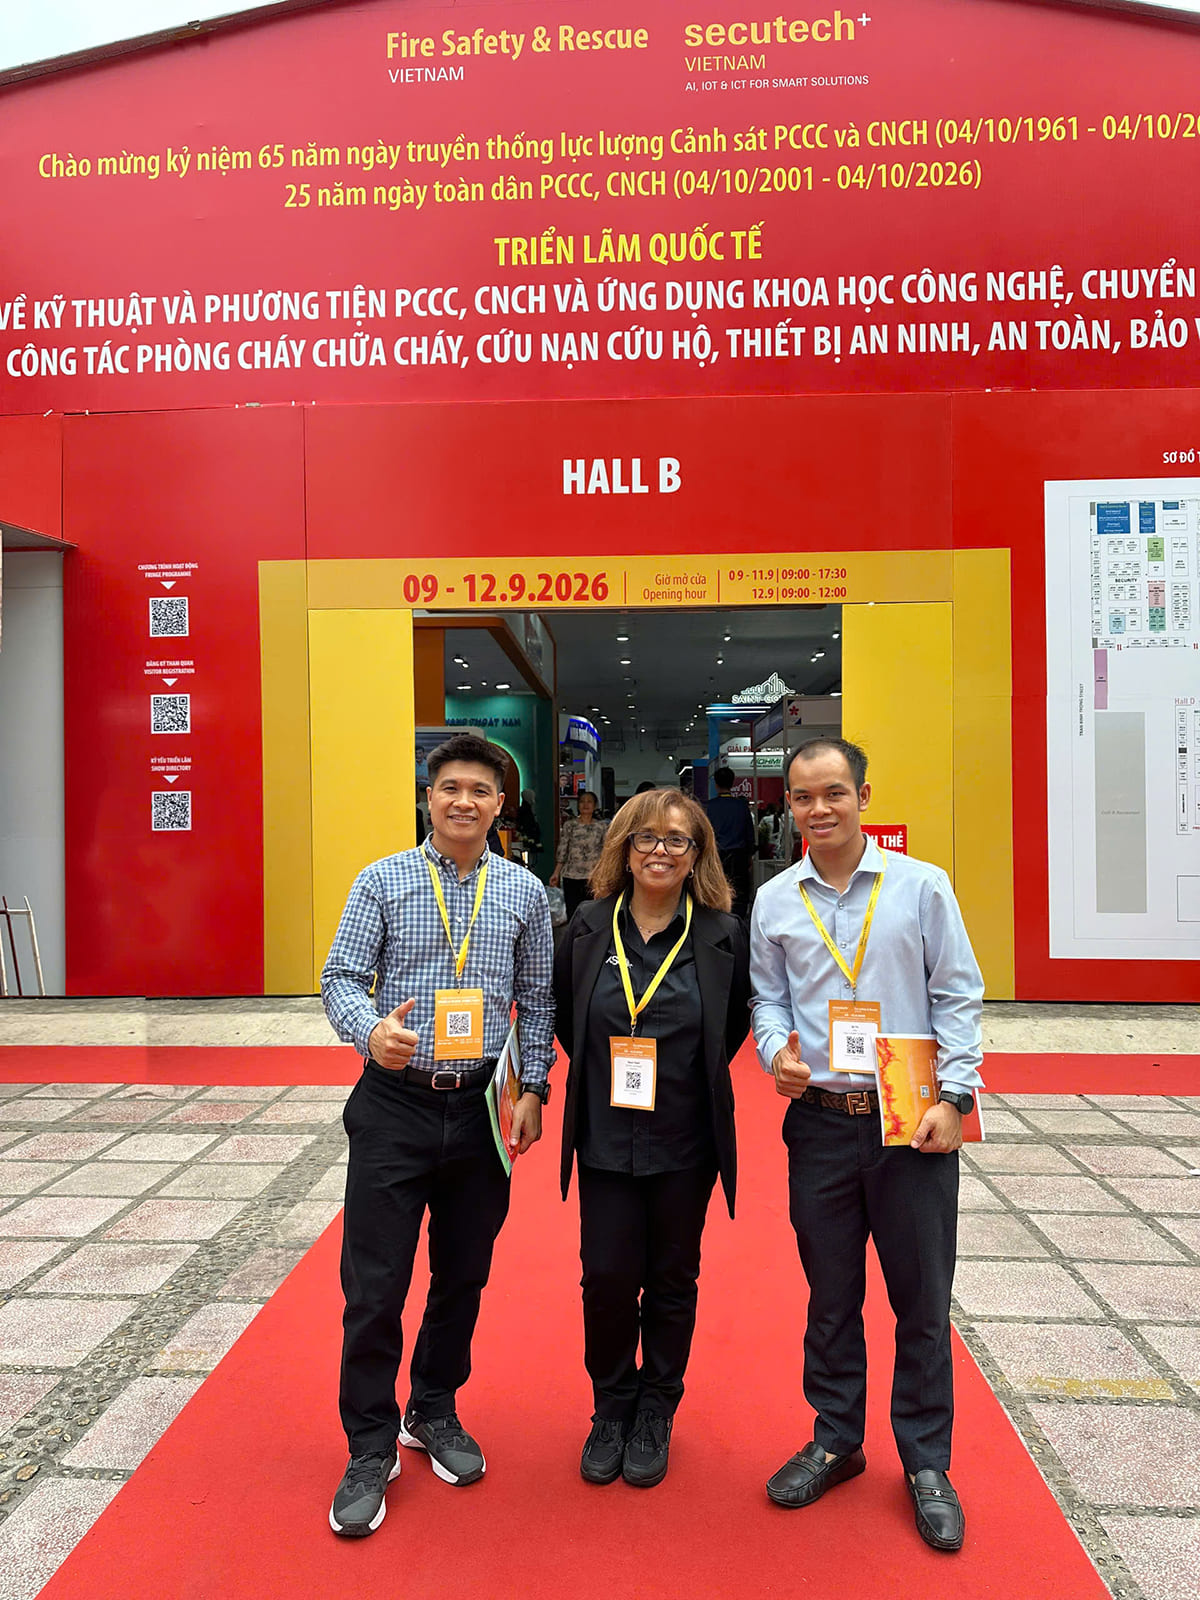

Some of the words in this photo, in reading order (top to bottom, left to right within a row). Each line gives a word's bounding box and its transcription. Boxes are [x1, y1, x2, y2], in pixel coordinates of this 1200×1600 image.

[387, 32, 435, 59] Fire
[442, 28, 525, 61] Safety
[532, 26, 552, 53] &
[559, 25, 649, 51] Rescue
[388, 66, 464, 84] VIETNAM
[685, 54, 766, 72] VIETNAM
[720, 80, 728, 90] &
[731, 80, 747, 90] ICT
[750, 79, 770, 89] FOR
[772, 77, 808, 88] SMART
[811, 75, 870, 87] SOLUTIONS
[39, 153, 91, 178] Chào
[98, 150, 159, 179] mừng
[167, 146, 191, 178] kỷ
[198, 144, 251, 176] niệm
[259, 144, 284, 168] 65
[292, 142, 339, 166] năm
[347, 139, 400, 170] ngày
[406, 134, 479, 168] truyền
[486, 131, 553, 164] thống
[561, 132, 592, 162] lực
[600, 131, 663, 161] lượng
[671, 127, 726, 153] Cảnh
[734, 126, 767, 151] sát
[775, 124, 828, 149] PCCC
[834, 122, 859, 147] và
[867, 120, 927, 146] CNCH
[936, 117, 1077, 148] (04/10/1961
[1103, 113, 1200, 140] 04/10/2
[285, 184, 310, 207] 25
[318, 182, 366, 206] năm
[374, 179, 427, 210] ngày
[433, 177, 484, 202] toàn
[491, 176, 532, 200] dân
[541, 173, 599, 201] PCCC,
[607, 171, 665, 196] CNCH
[674, 167, 812, 199] (04/10/2001
[837, 160, 981, 190] 04/10/2026)
[494, 226, 573, 266] TRIỂN
[584, 228, 640, 263] LÃM
[649, 223, 724, 265] QUỐC
[730, 221, 765, 259] TẾ
[34, 294, 67, 329] KỸ
[72, 292, 156, 333] THUẬT
[162, 290, 196, 324] VÀ
[205, 290, 319, 322] PHƯƠNG
[326, 284, 385, 326] TIỆN
[396, 287, 467, 320] PCCC,
[475, 285, 545, 314] CNCH
[553, 278, 589, 312] VÀ
[598, 277, 656, 311] ỨNG
[666, 280, 744, 318] DỤNG
[754, 277, 829, 308] KHOA
[838, 275, 894, 313] HỌC
[902, 268, 977, 303] CÔNG
[987, 264, 1073, 308] NGHỆ,
[1082, 258, 1195, 299] CHUYỂN
[7, 343, 76, 377] CÔNG
[83, 341, 129, 374] TÁC
[137, 338, 229, 373] PHÒNG
[238, 335, 306, 369] CHÁY
[313, 332, 386, 367] CHỮA
[394, 330, 469, 368] CHÁY,
[477, 328, 531, 363] CỨU
[542, 332, 598, 369] NẠN
[607, 325, 662, 360] CỨU
[673, 324, 719, 367] HỘ,
[726, 318, 805, 358] THIẾT
[814, 326, 840, 363] BỊ
[849, 325, 888, 354] AN
[898, 322, 980, 356] NINH,
[988, 321, 1027, 351] AN
[1035, 314, 1121, 354] TOÀN,
[1131, 309, 1188, 348] BẢO
[1163, 451, 1177, 464] SƠ
[563, 458, 649, 494] HALL
[659, 457, 682, 493] B
[403, 574, 439, 603] 09
[463, 572, 609, 602] 12.9.2026
[655, 573, 671, 586] Giờ
[673, 573, 688, 585] mở
[691, 572, 707, 585] cửa
[643, 588, 683, 602] Opening
[684, 588, 707, 599] hour
[752, 588, 774, 599] 12.9
[781, 587, 810, 598] 09:00
[819, 587, 847, 598] 12:00
[881, 831, 904, 848] THẺ
